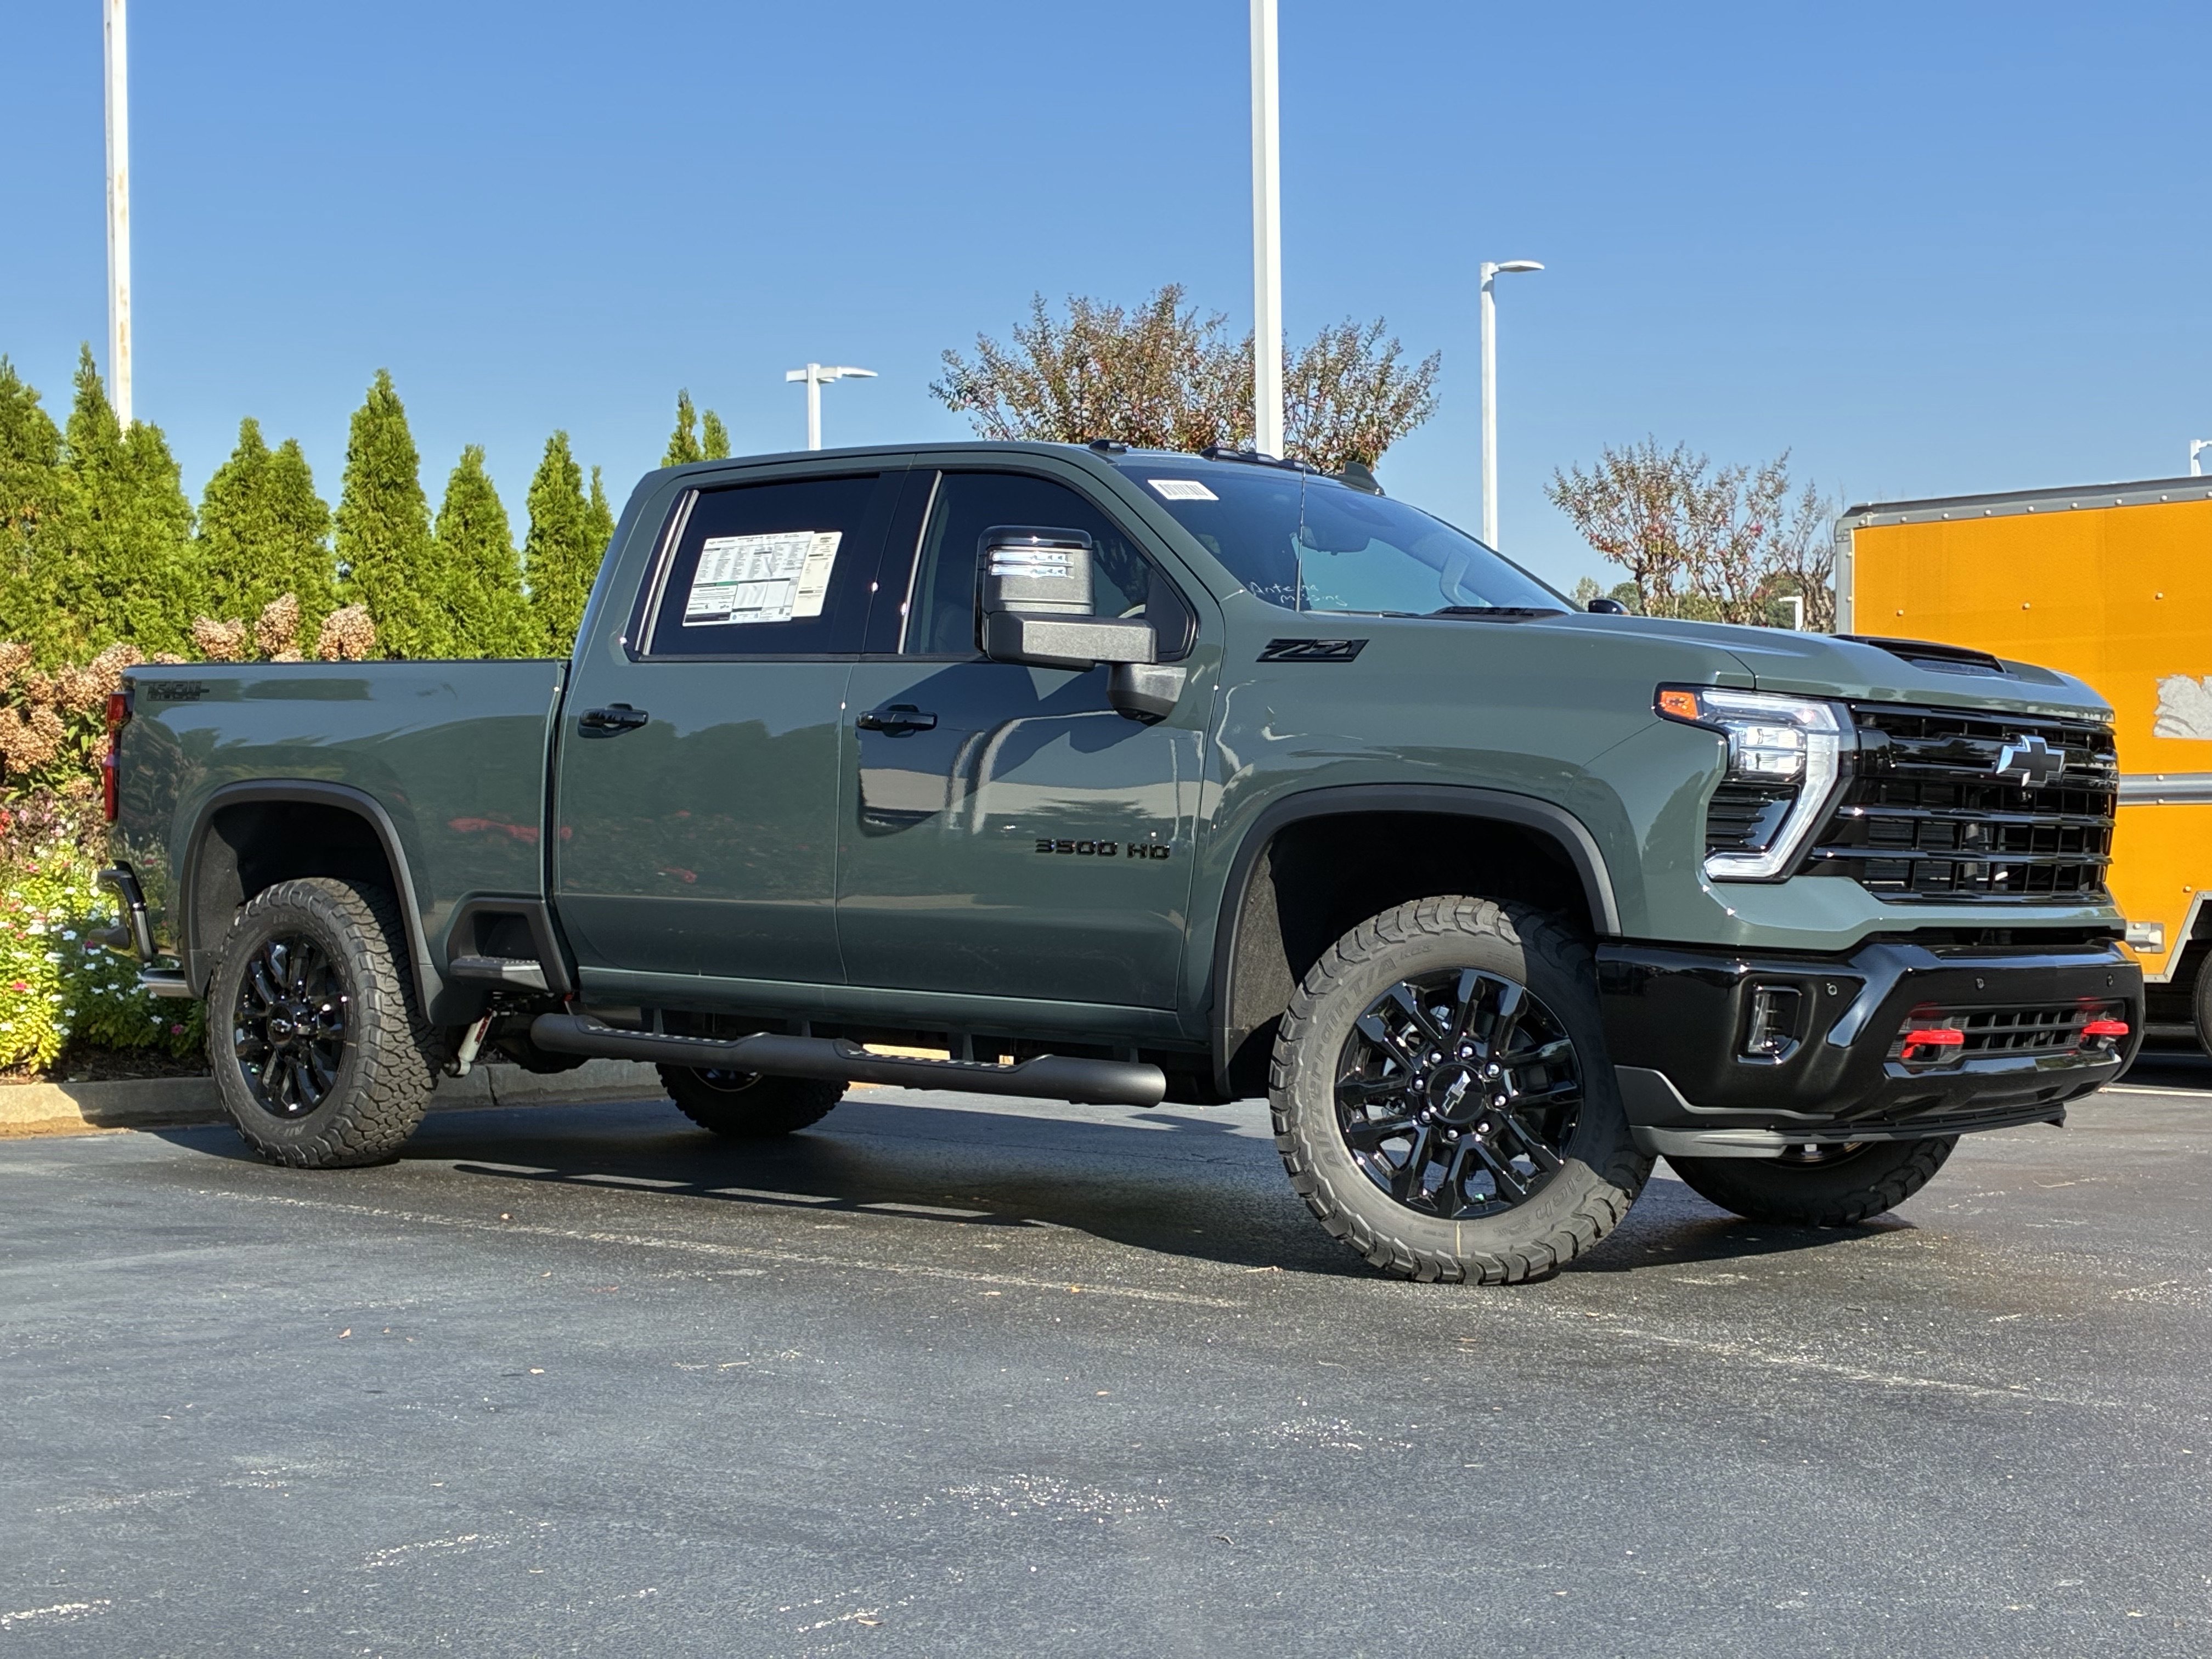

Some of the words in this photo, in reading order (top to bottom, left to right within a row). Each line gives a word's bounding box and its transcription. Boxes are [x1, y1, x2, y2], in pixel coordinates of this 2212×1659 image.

[1255, 637, 1370, 663] Z71
[1035, 838, 1118, 857] 3500
[1126, 842, 1171, 860] HD
